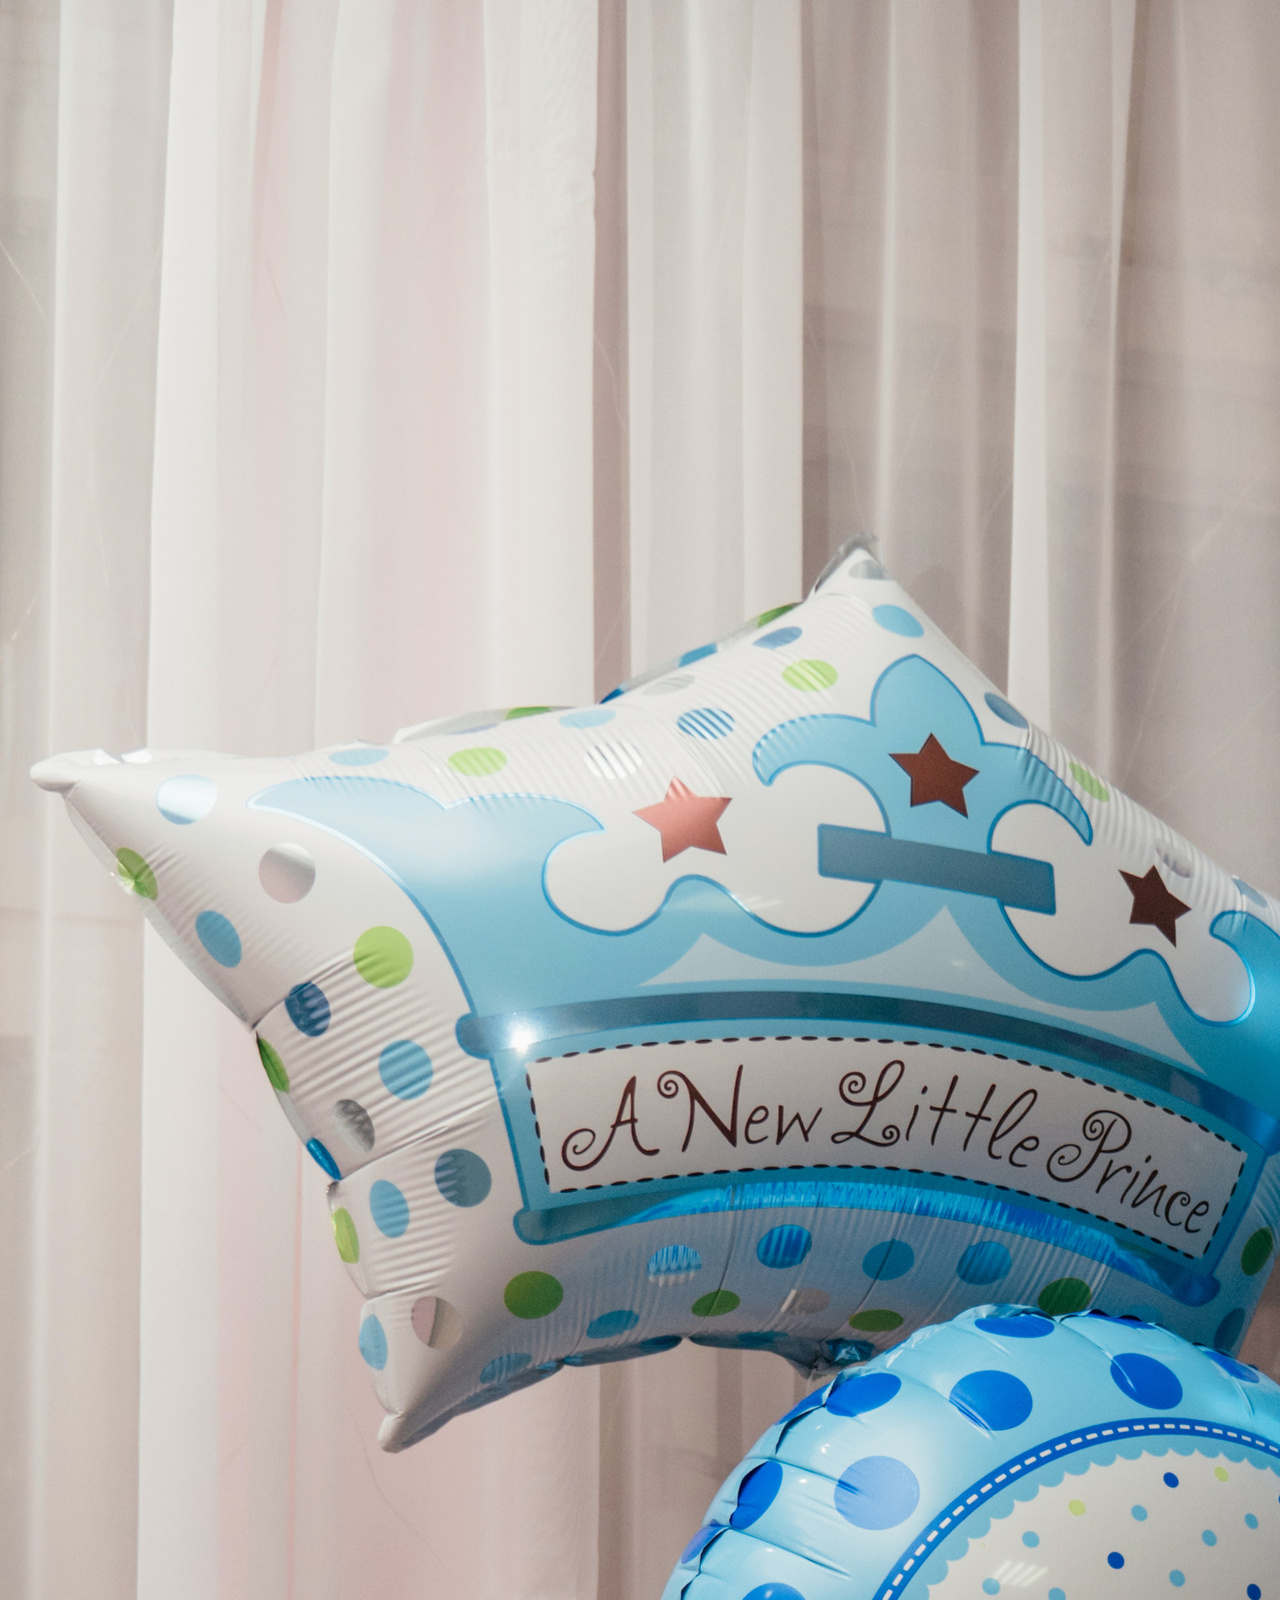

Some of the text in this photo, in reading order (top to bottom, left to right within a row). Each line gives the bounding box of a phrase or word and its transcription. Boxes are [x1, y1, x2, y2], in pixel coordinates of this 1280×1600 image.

[561, 1059, 1210, 1234] A New Little Prince
